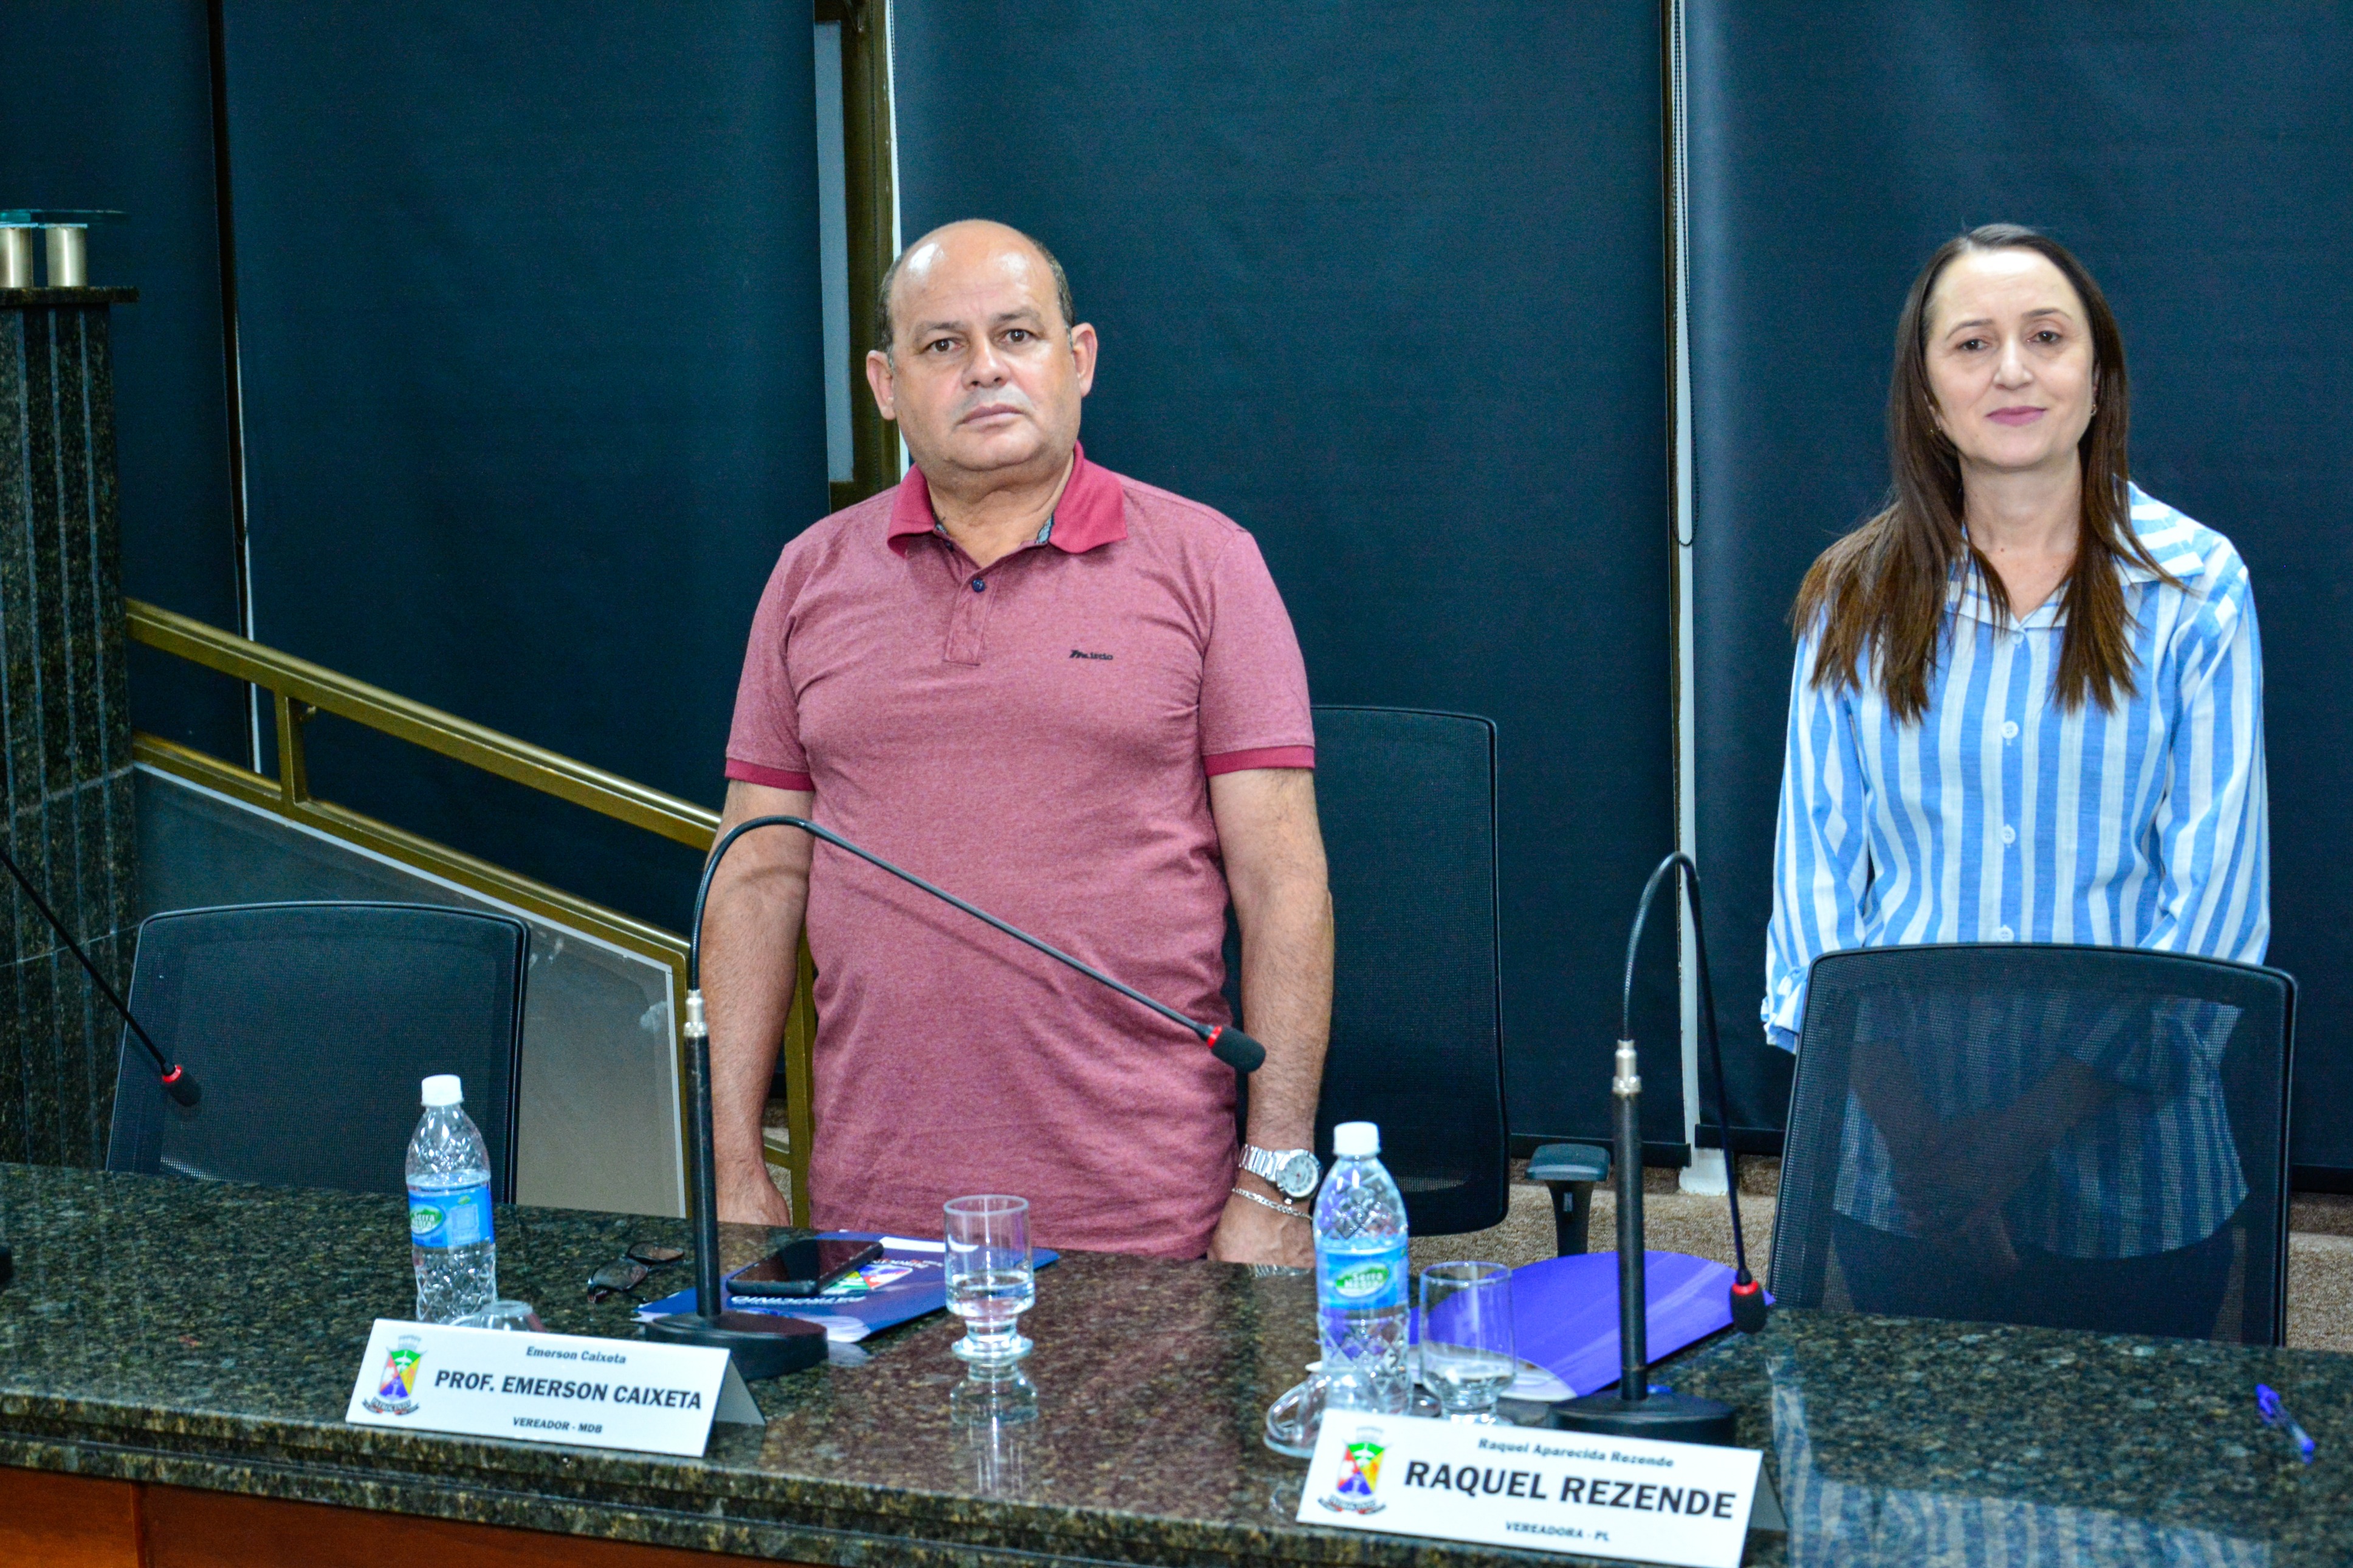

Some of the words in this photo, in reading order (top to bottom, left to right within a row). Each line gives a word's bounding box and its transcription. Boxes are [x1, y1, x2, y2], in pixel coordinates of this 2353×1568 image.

[526, 1346, 578, 1360] Emerson
[581, 1350, 627, 1364] Caixeta
[434, 1369, 495, 1392] PROF.
[501, 1374, 608, 1402] EMERSON
[613, 1385, 701, 1409] CAIXETA
[513, 1416, 570, 1431] VEREADOR
[578, 1422, 603, 1433] MDB
[1478, 1437, 1529, 1453] Raquel
[1533, 1444, 1606, 1460] Aparecida
[1610, 1451, 1674, 1467] Rezende
[1404, 1459, 1547, 1499] RAQUEL
[1559, 1475, 1737, 1519] REZENDE
[1505, 1521, 1583, 1538] VEREADORA
[1595, 1530, 1610, 1541] PL
